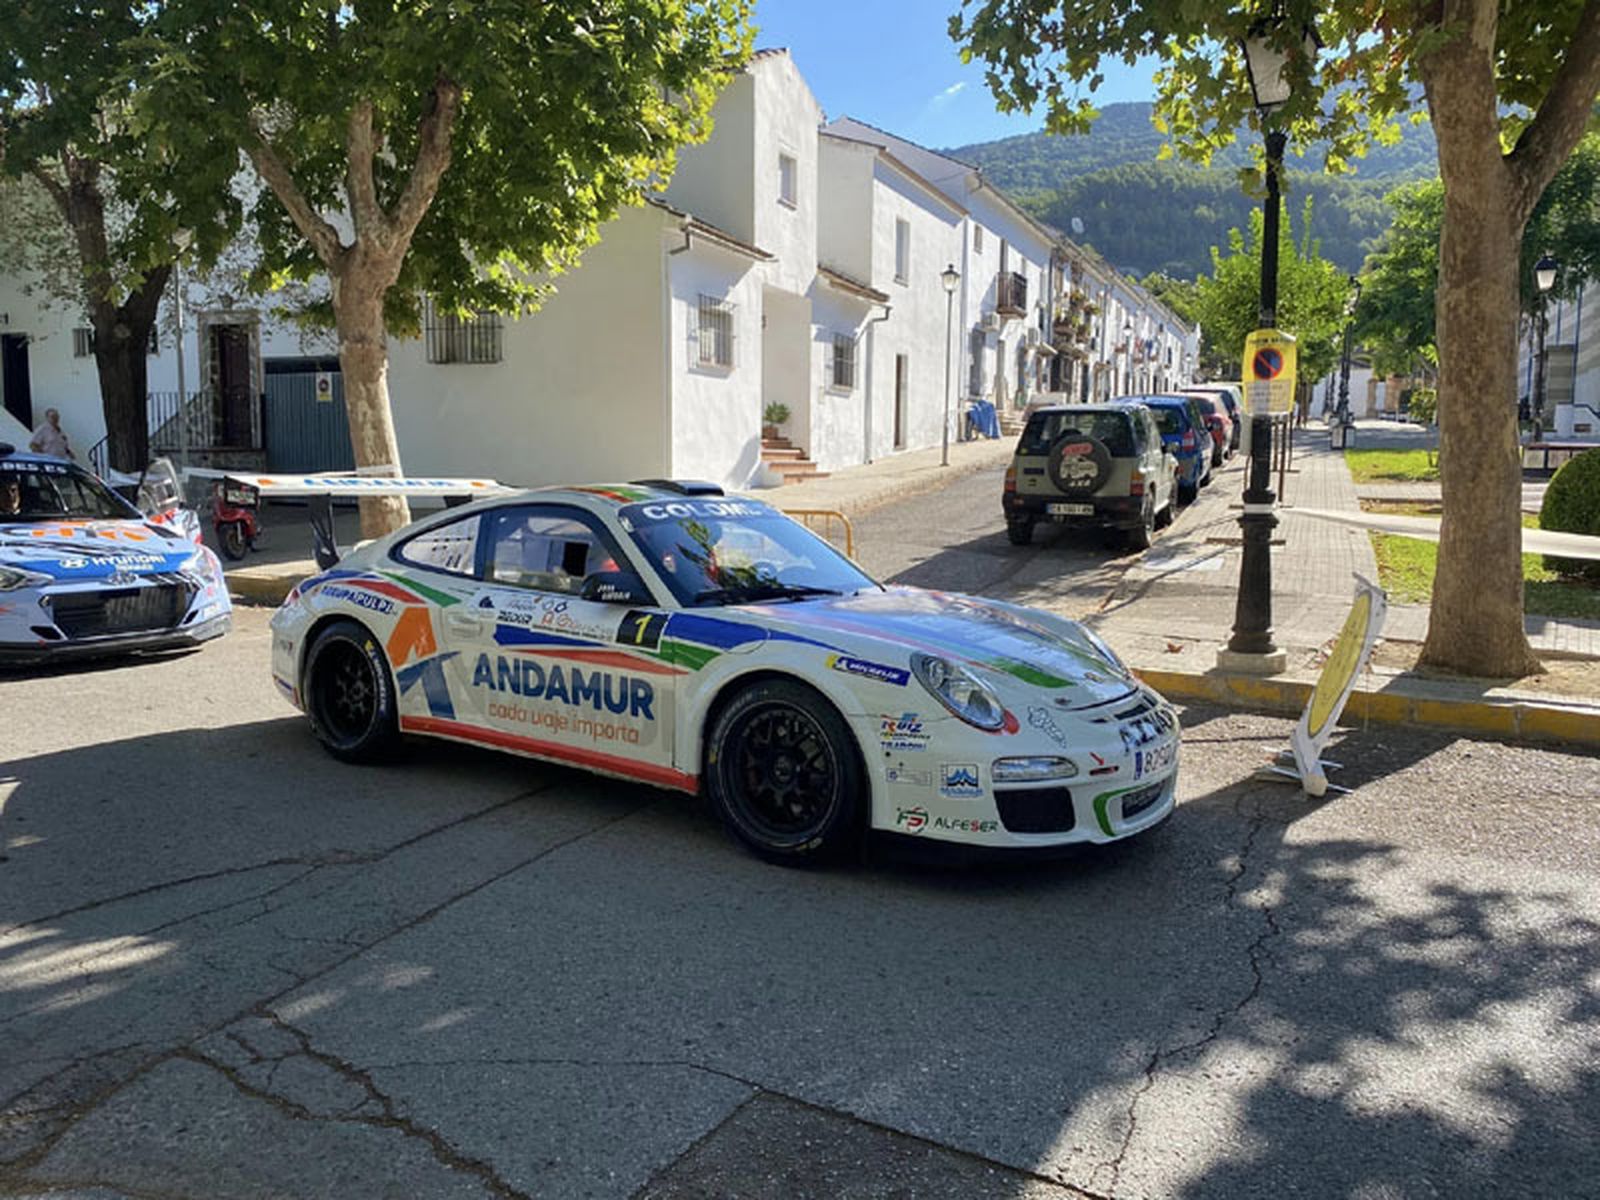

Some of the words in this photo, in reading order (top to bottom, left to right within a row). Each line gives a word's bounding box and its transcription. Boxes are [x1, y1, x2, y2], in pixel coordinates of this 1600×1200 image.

[632, 614, 653, 645] 1
[472, 652, 655, 721] ANDAMUR
[488, 702, 527, 722] cada
[572, 717, 640, 744] importa
[934, 816, 999, 833] ALFESER
